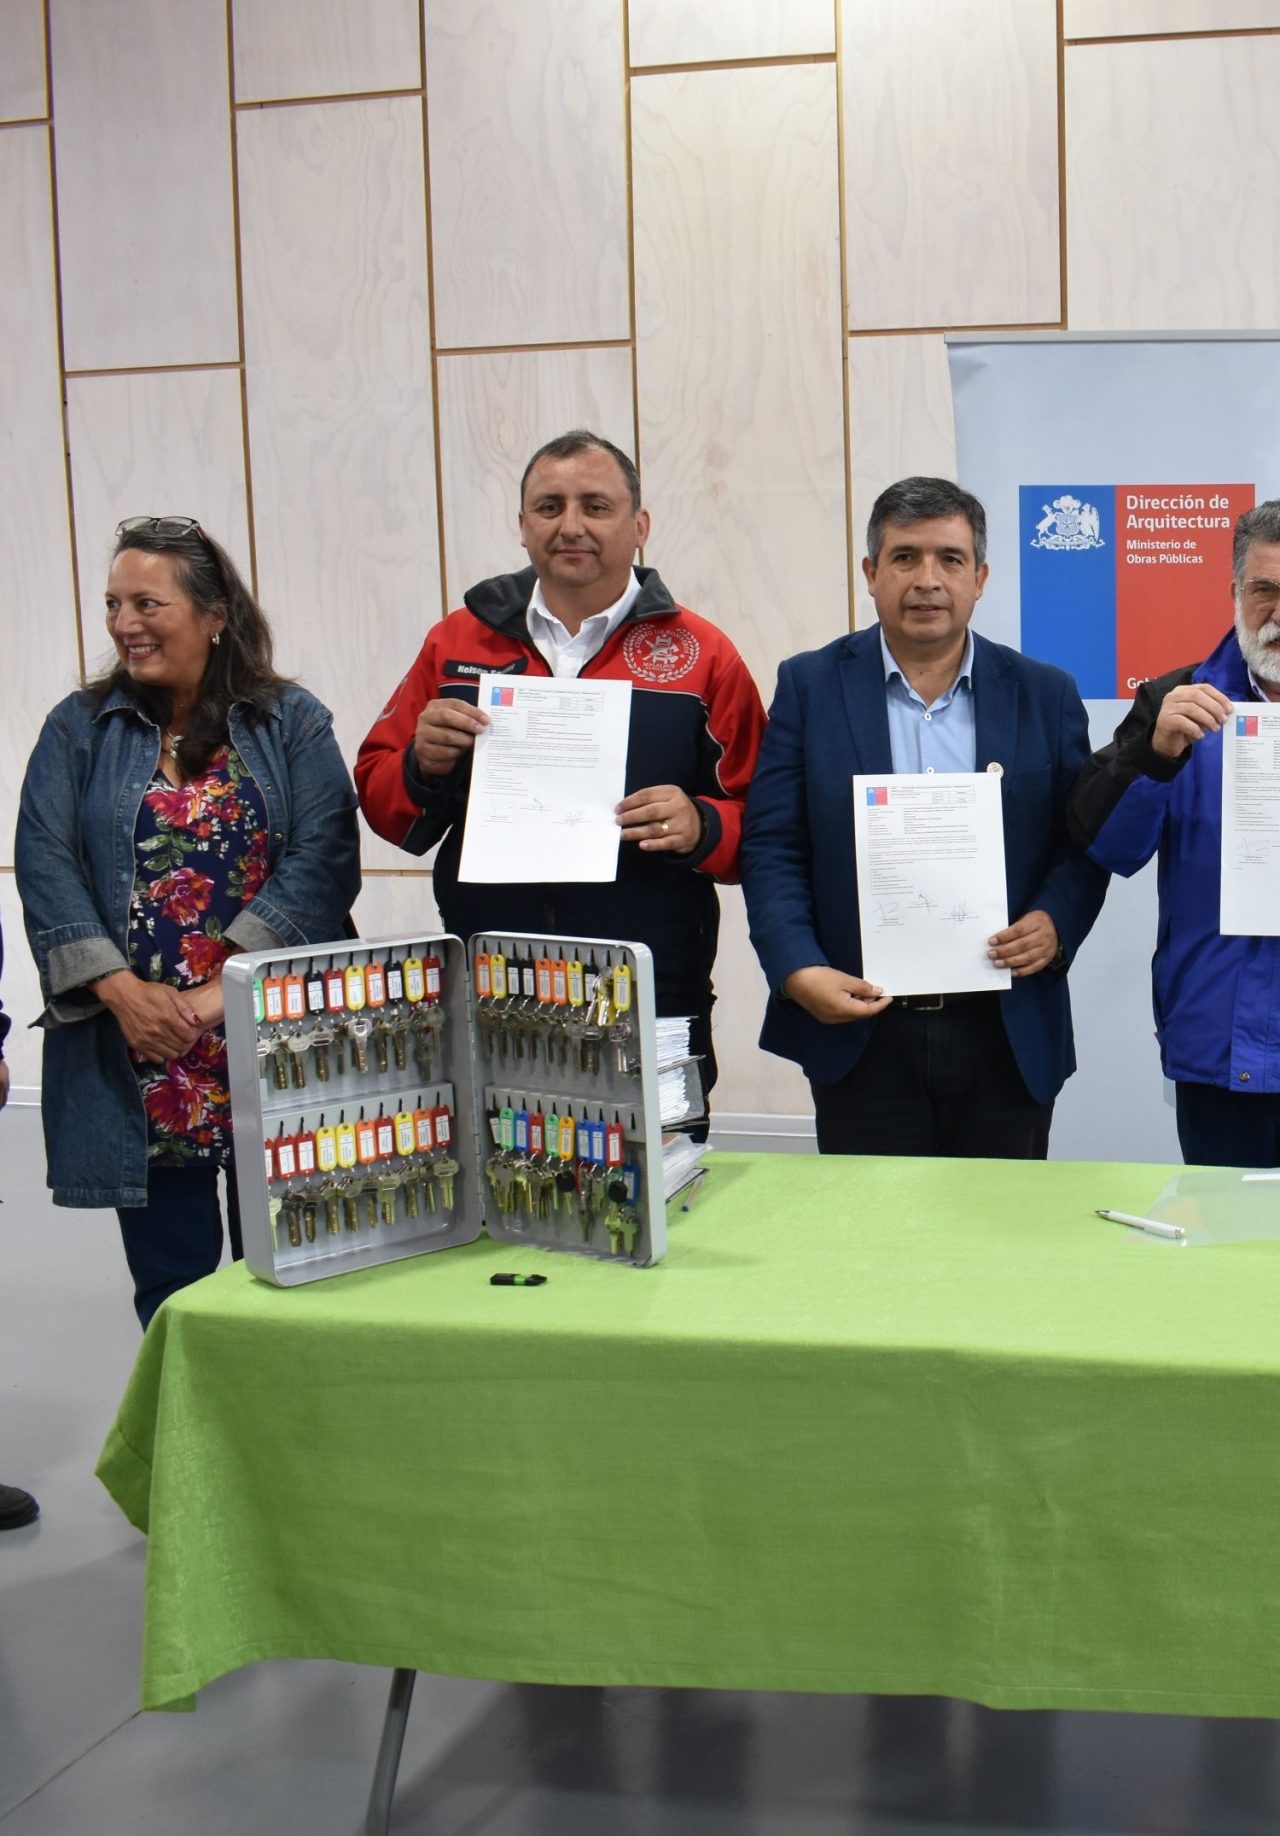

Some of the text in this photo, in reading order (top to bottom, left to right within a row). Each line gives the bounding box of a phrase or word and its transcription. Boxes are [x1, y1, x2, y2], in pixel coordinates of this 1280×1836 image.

[1126, 494, 1229, 510] Dirección de
[1126, 514, 1230, 532] Arquitectura
[1126, 539, 1197, 550] Ministerio de
[1126, 553, 1203, 564] Obras Públicas
